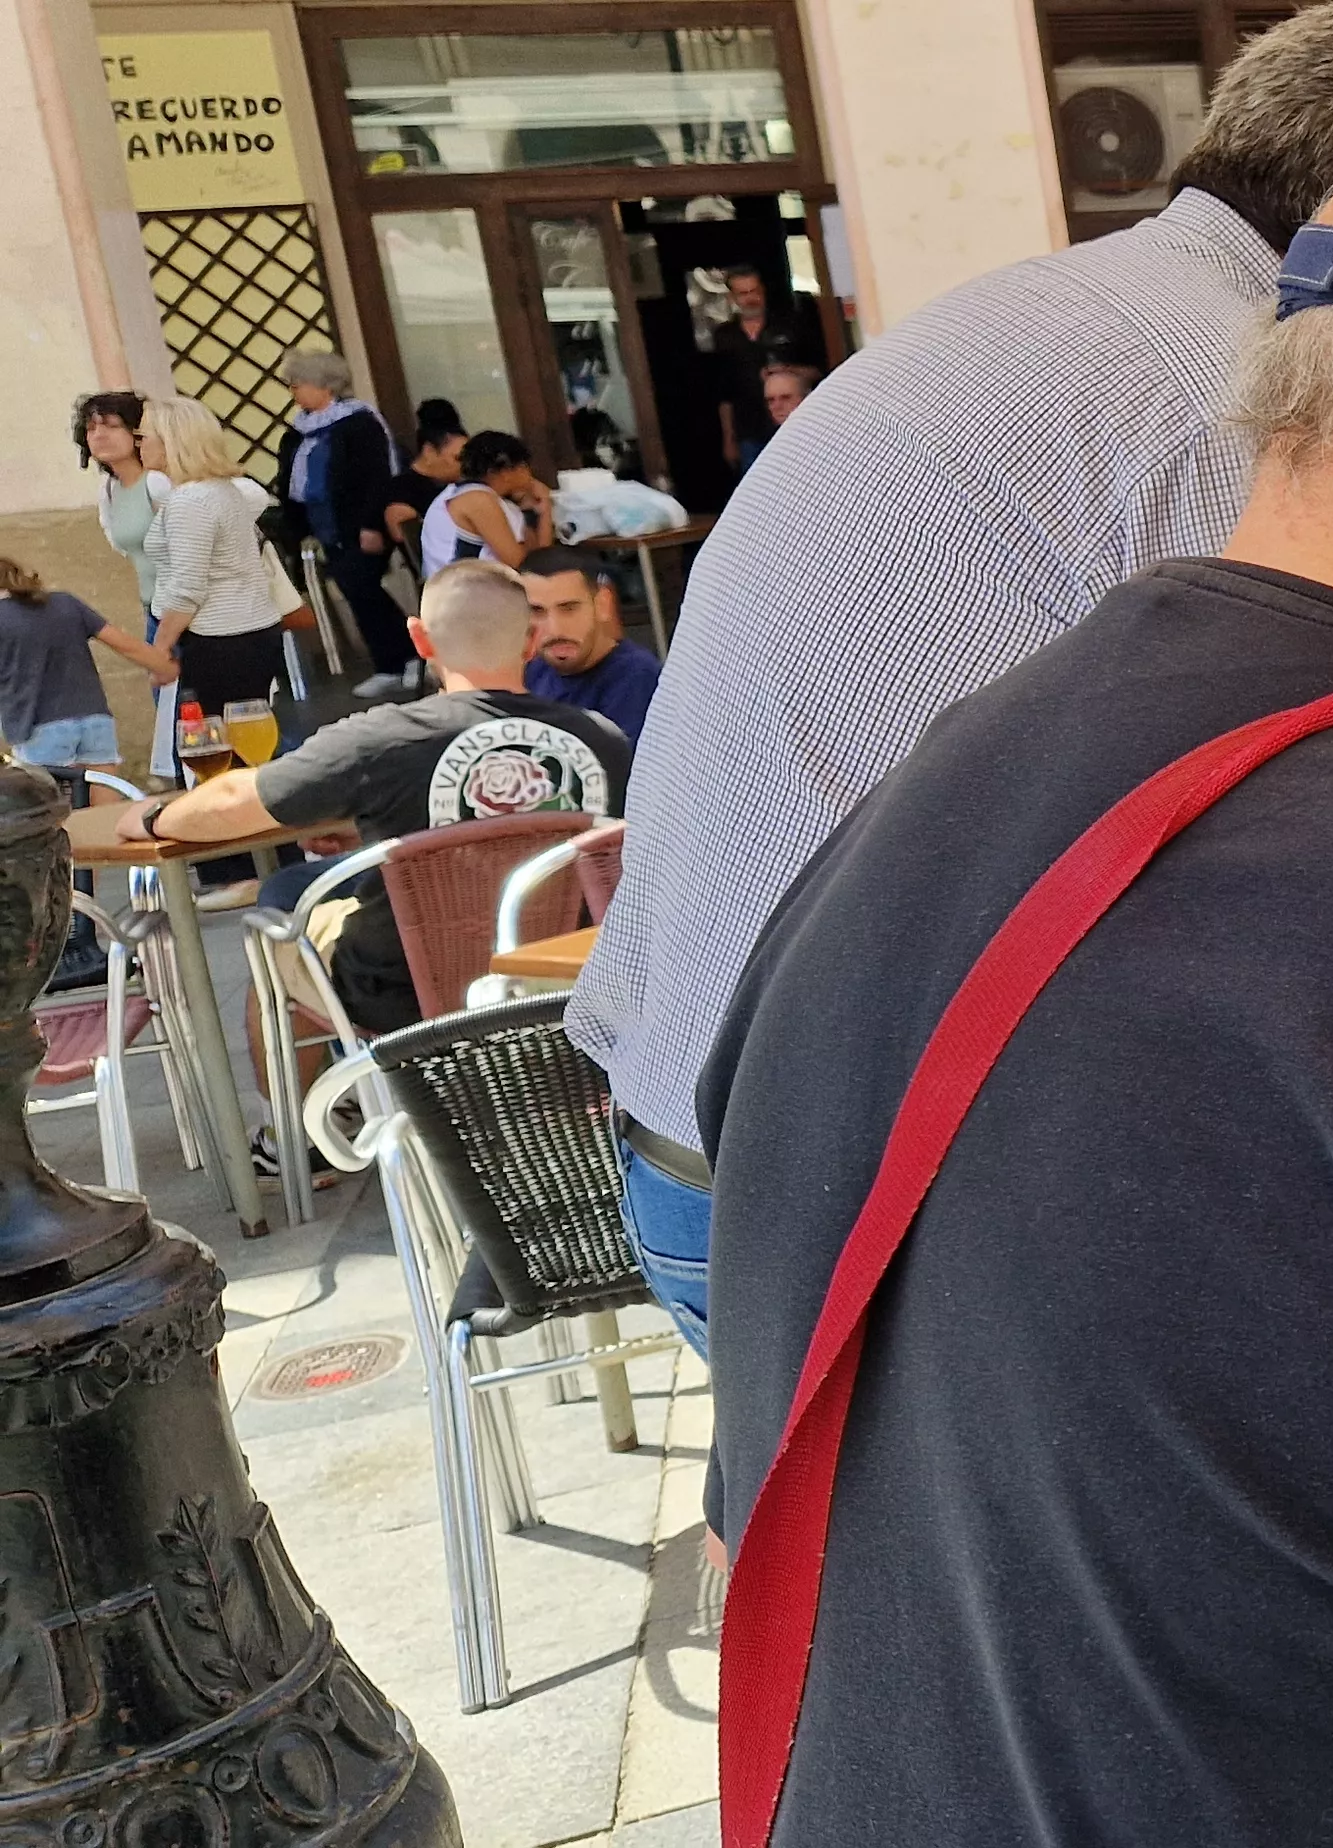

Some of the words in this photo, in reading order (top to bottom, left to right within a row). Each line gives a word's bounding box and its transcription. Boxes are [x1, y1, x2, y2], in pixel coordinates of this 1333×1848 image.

[111, 96, 283, 124] RECUERDO
[126, 130, 275, 161] AMANDO
[435, 729, 495, 789] VANS
[500, 722, 602, 788] CLASSIC
